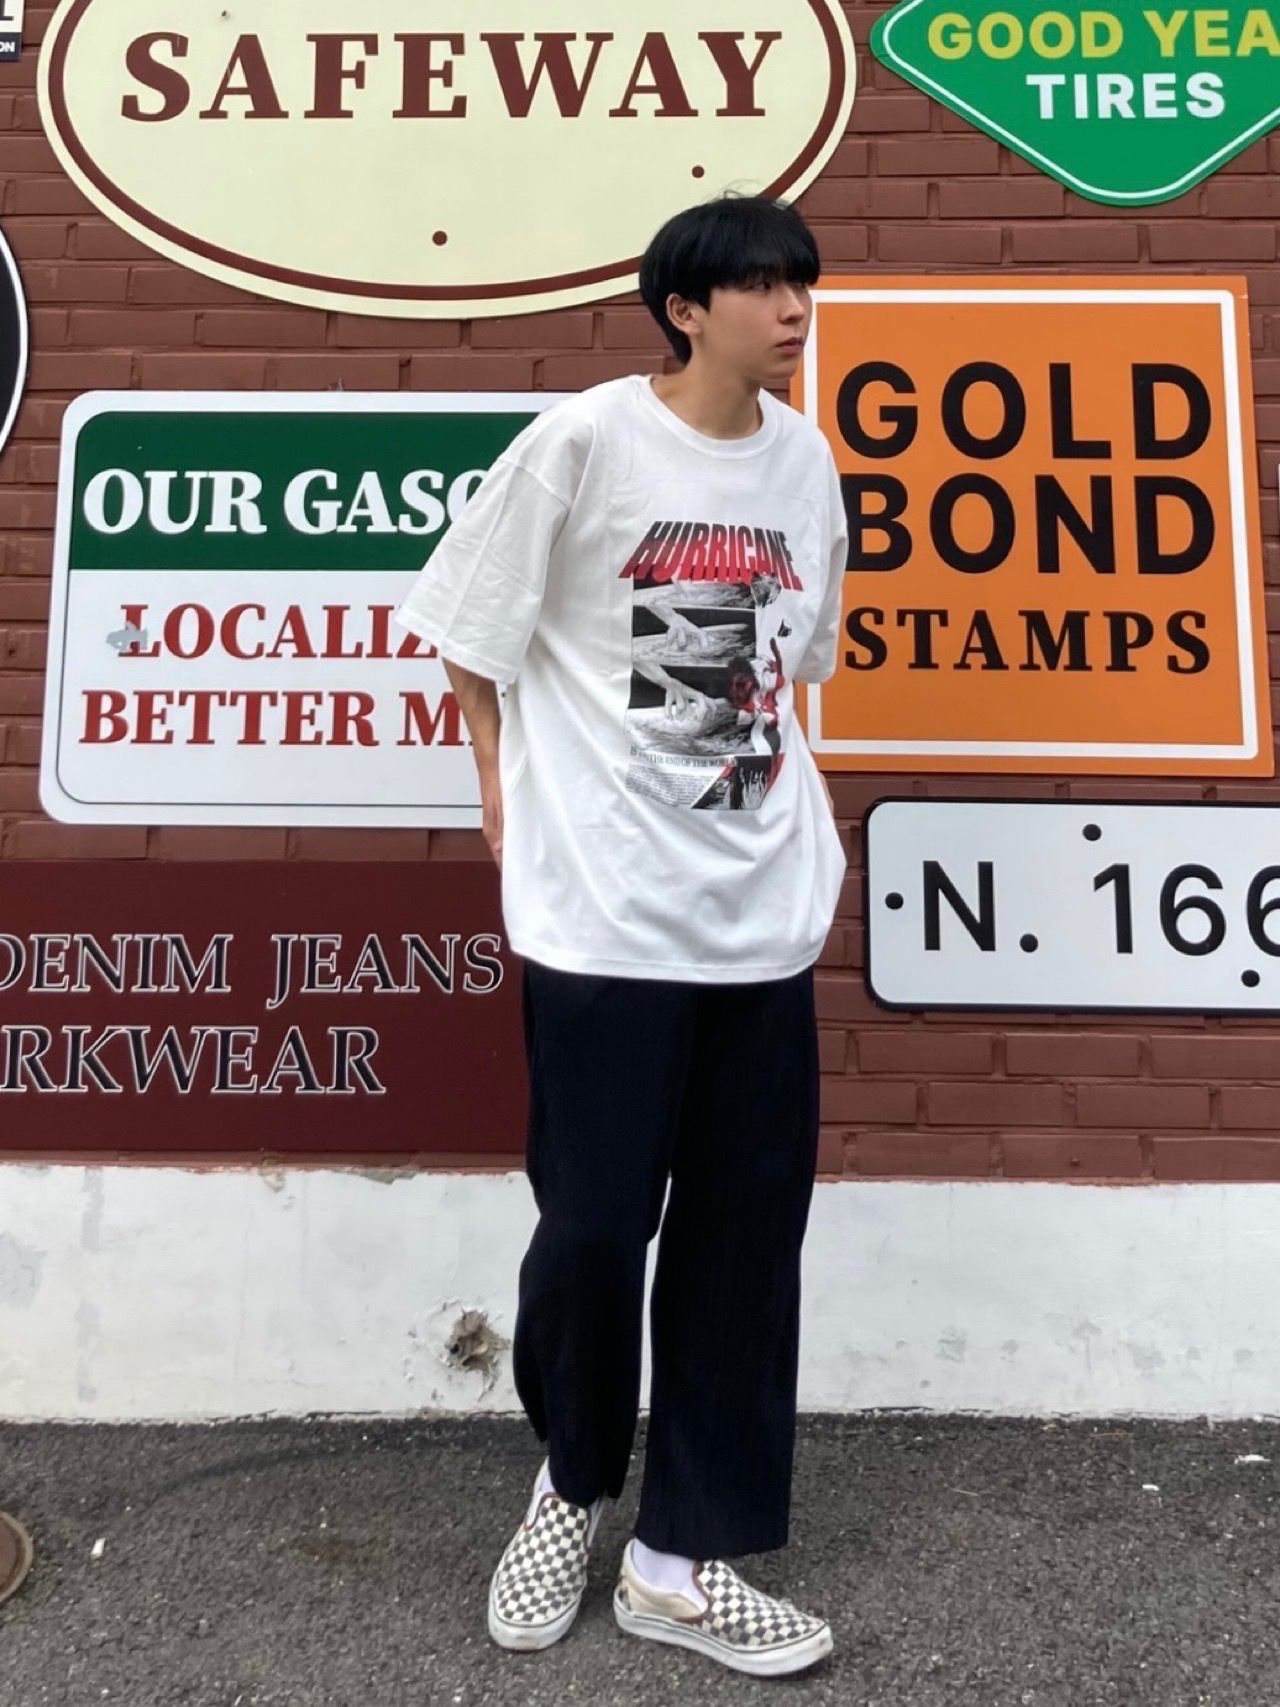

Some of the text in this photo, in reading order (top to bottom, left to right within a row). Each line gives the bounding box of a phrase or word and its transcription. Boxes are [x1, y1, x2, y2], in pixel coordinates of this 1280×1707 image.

[927, 9, 1280, 60] GOOD YEA
[121, 31, 782, 122] SAFEWAY
[1026, 72, 1226, 120] TIRES
[836, 360, 1212, 460] GOLD
[83, 468, 267, 534] OUR
[840, 472, 1216, 575] BOND
[618, 520, 804, 592] HURRICANE
[845, 606, 1211, 675] STAMPS
[78, 690, 474, 747] BETTER M
[266, 933, 505, 1010] JEANS
[0, 1024, 387, 1095] RKWEAR
